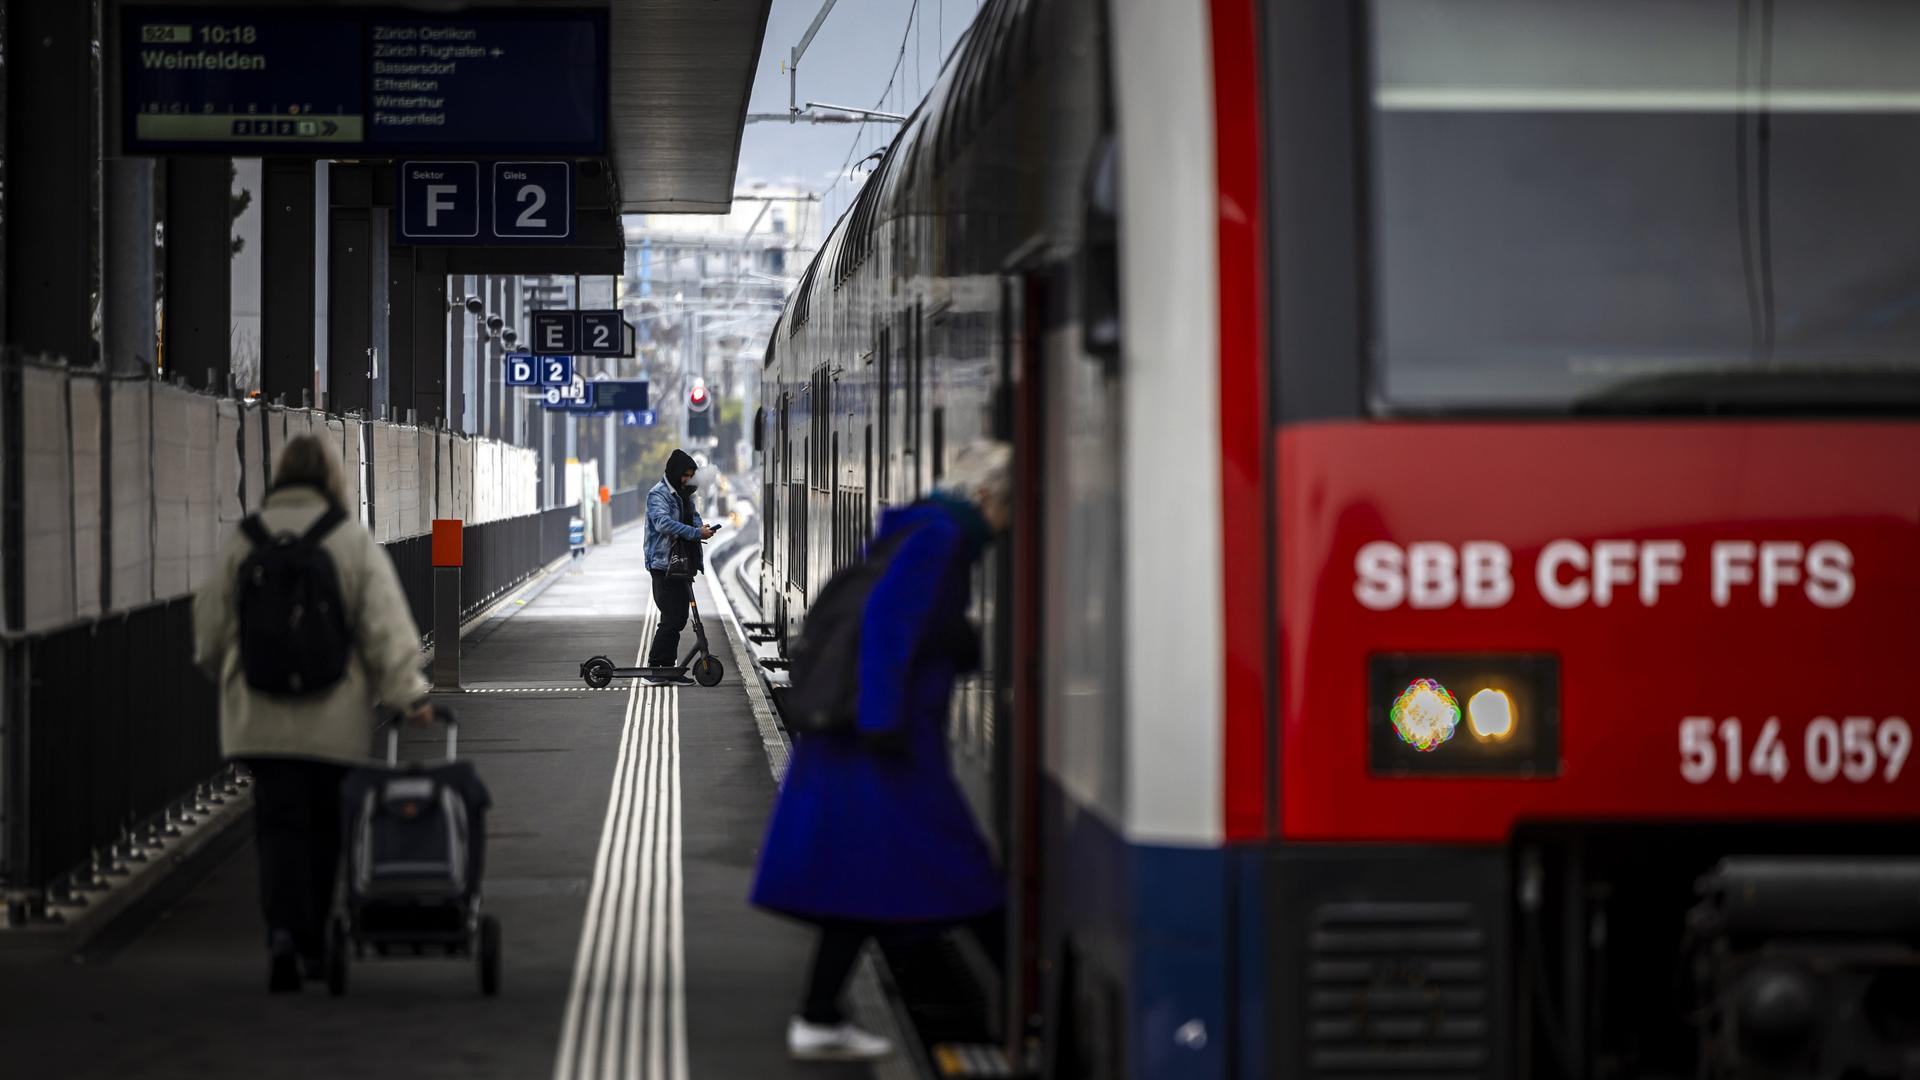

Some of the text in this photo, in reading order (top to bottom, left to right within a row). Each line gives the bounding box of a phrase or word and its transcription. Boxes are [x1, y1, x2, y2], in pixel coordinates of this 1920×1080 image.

[200, 25, 257, 44] 10:18
[143, 51, 265, 69] Weinfelden
[375, 95, 445, 109] Winterthur
[412, 171, 444, 180] Sektor
[503, 171, 527, 180] Gleis
[426, 184, 547, 227] F 2
[546, 325, 609, 348] E 2
[514, 362, 563, 381] D 2
[1353, 539, 1856, 610] SBB CFF FFS
[1678, 716, 1911, 783] 514 059
